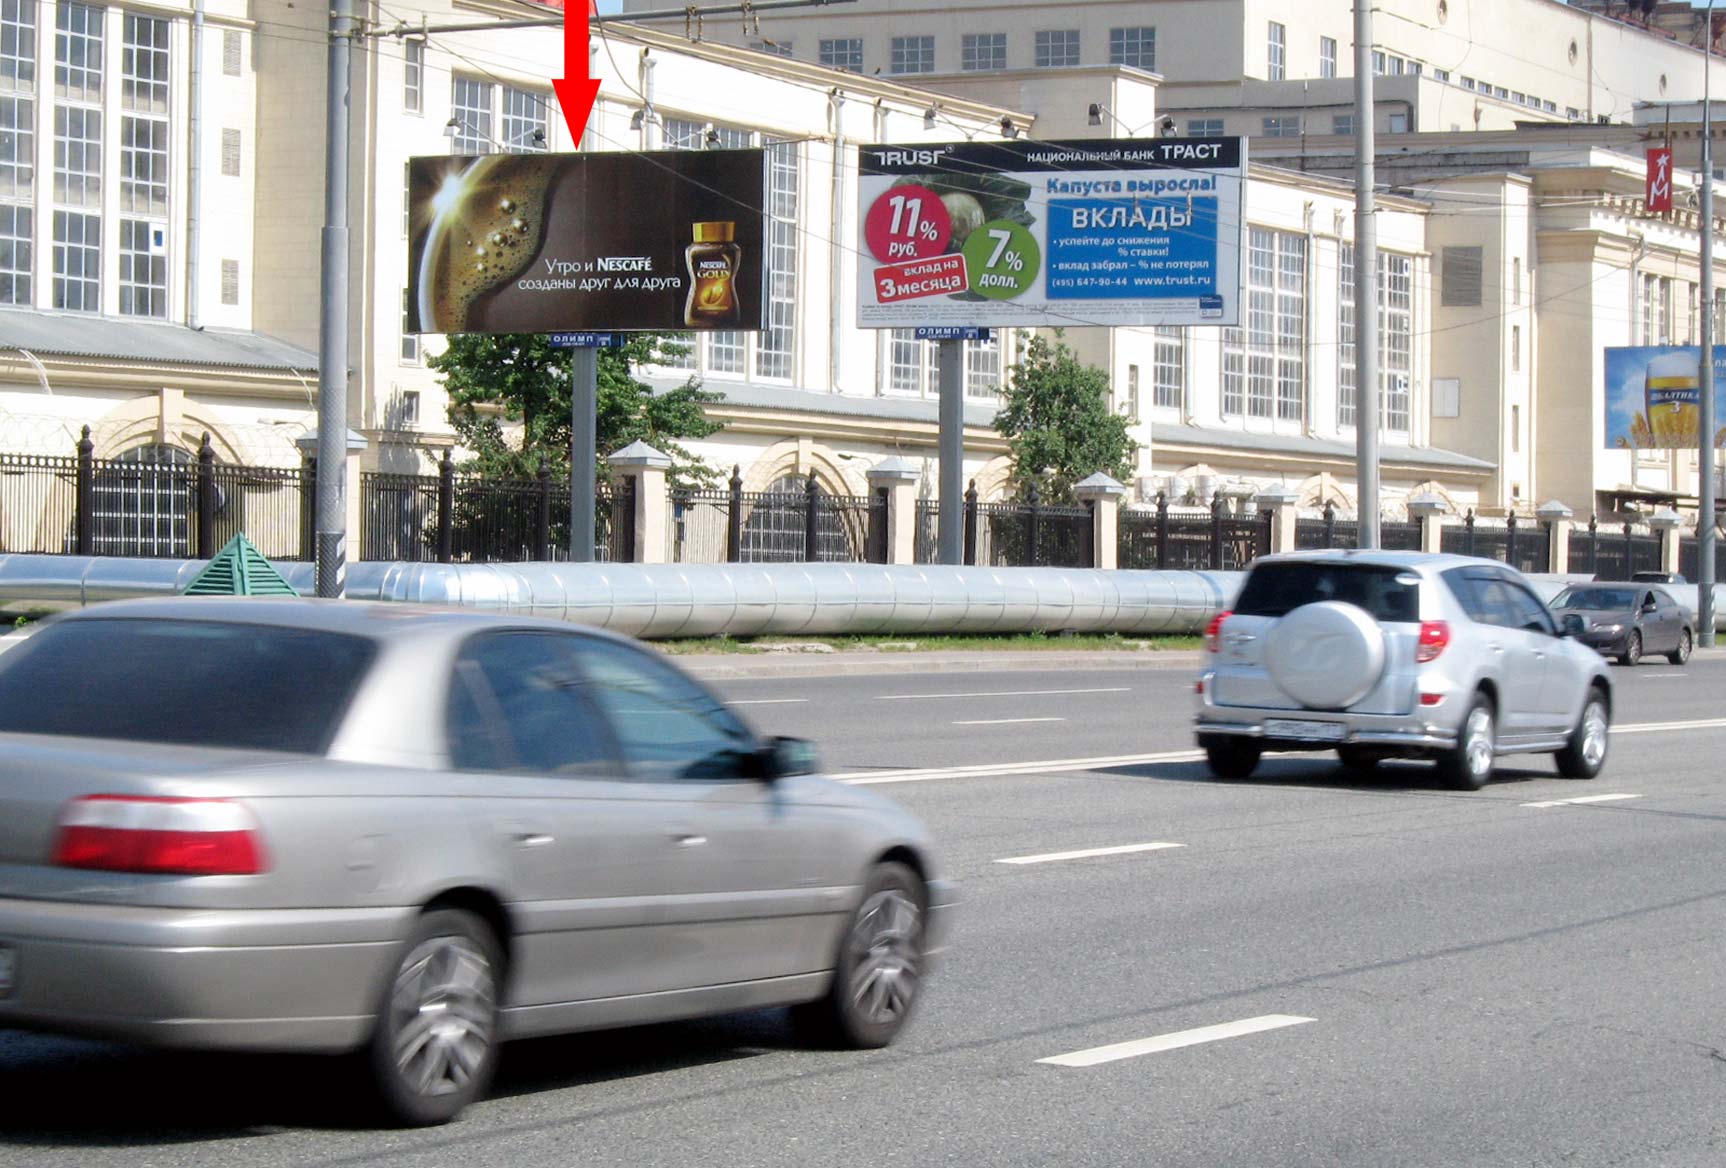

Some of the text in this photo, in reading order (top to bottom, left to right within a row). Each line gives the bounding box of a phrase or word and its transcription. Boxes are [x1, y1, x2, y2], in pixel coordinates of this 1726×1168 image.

[873, 150, 946, 166] TRUST
[1027, 144, 1222, 164] НАЦИОНАЛЬНЫЙ БАНК ТРАСТ
[1047, 175, 1217, 196] Капуста выросла!
[1072, 206, 1192, 230] ВКЛАДЫ
[1058, 236, 1170, 247] успейте до снижения
[888, 242, 918, 258] руб.
[1130, 247, 1169, 257] ставки!
[545, 257, 581, 275] Утро
[584, 262, 593, 272] и
[904, 259, 959, 277] вклад на
[1058, 261, 1090, 271] вклад
[1091, 260, 1128, 271] забрал
[1150, 261, 1163, 270] не
[1165, 260, 1209, 271] потерял
[697, 270, 729, 279] GOLD
[979, 273, 1019, 289] долл.
[1134, 275, 1211, 286] www.trust.ru
[518, 277, 681, 292] созданы друг для друга
[919, 327, 960, 335] ОЛИМП
[553, 335, 594, 343] ОЛИМП
[1670, 400, 1681, 413] 3
